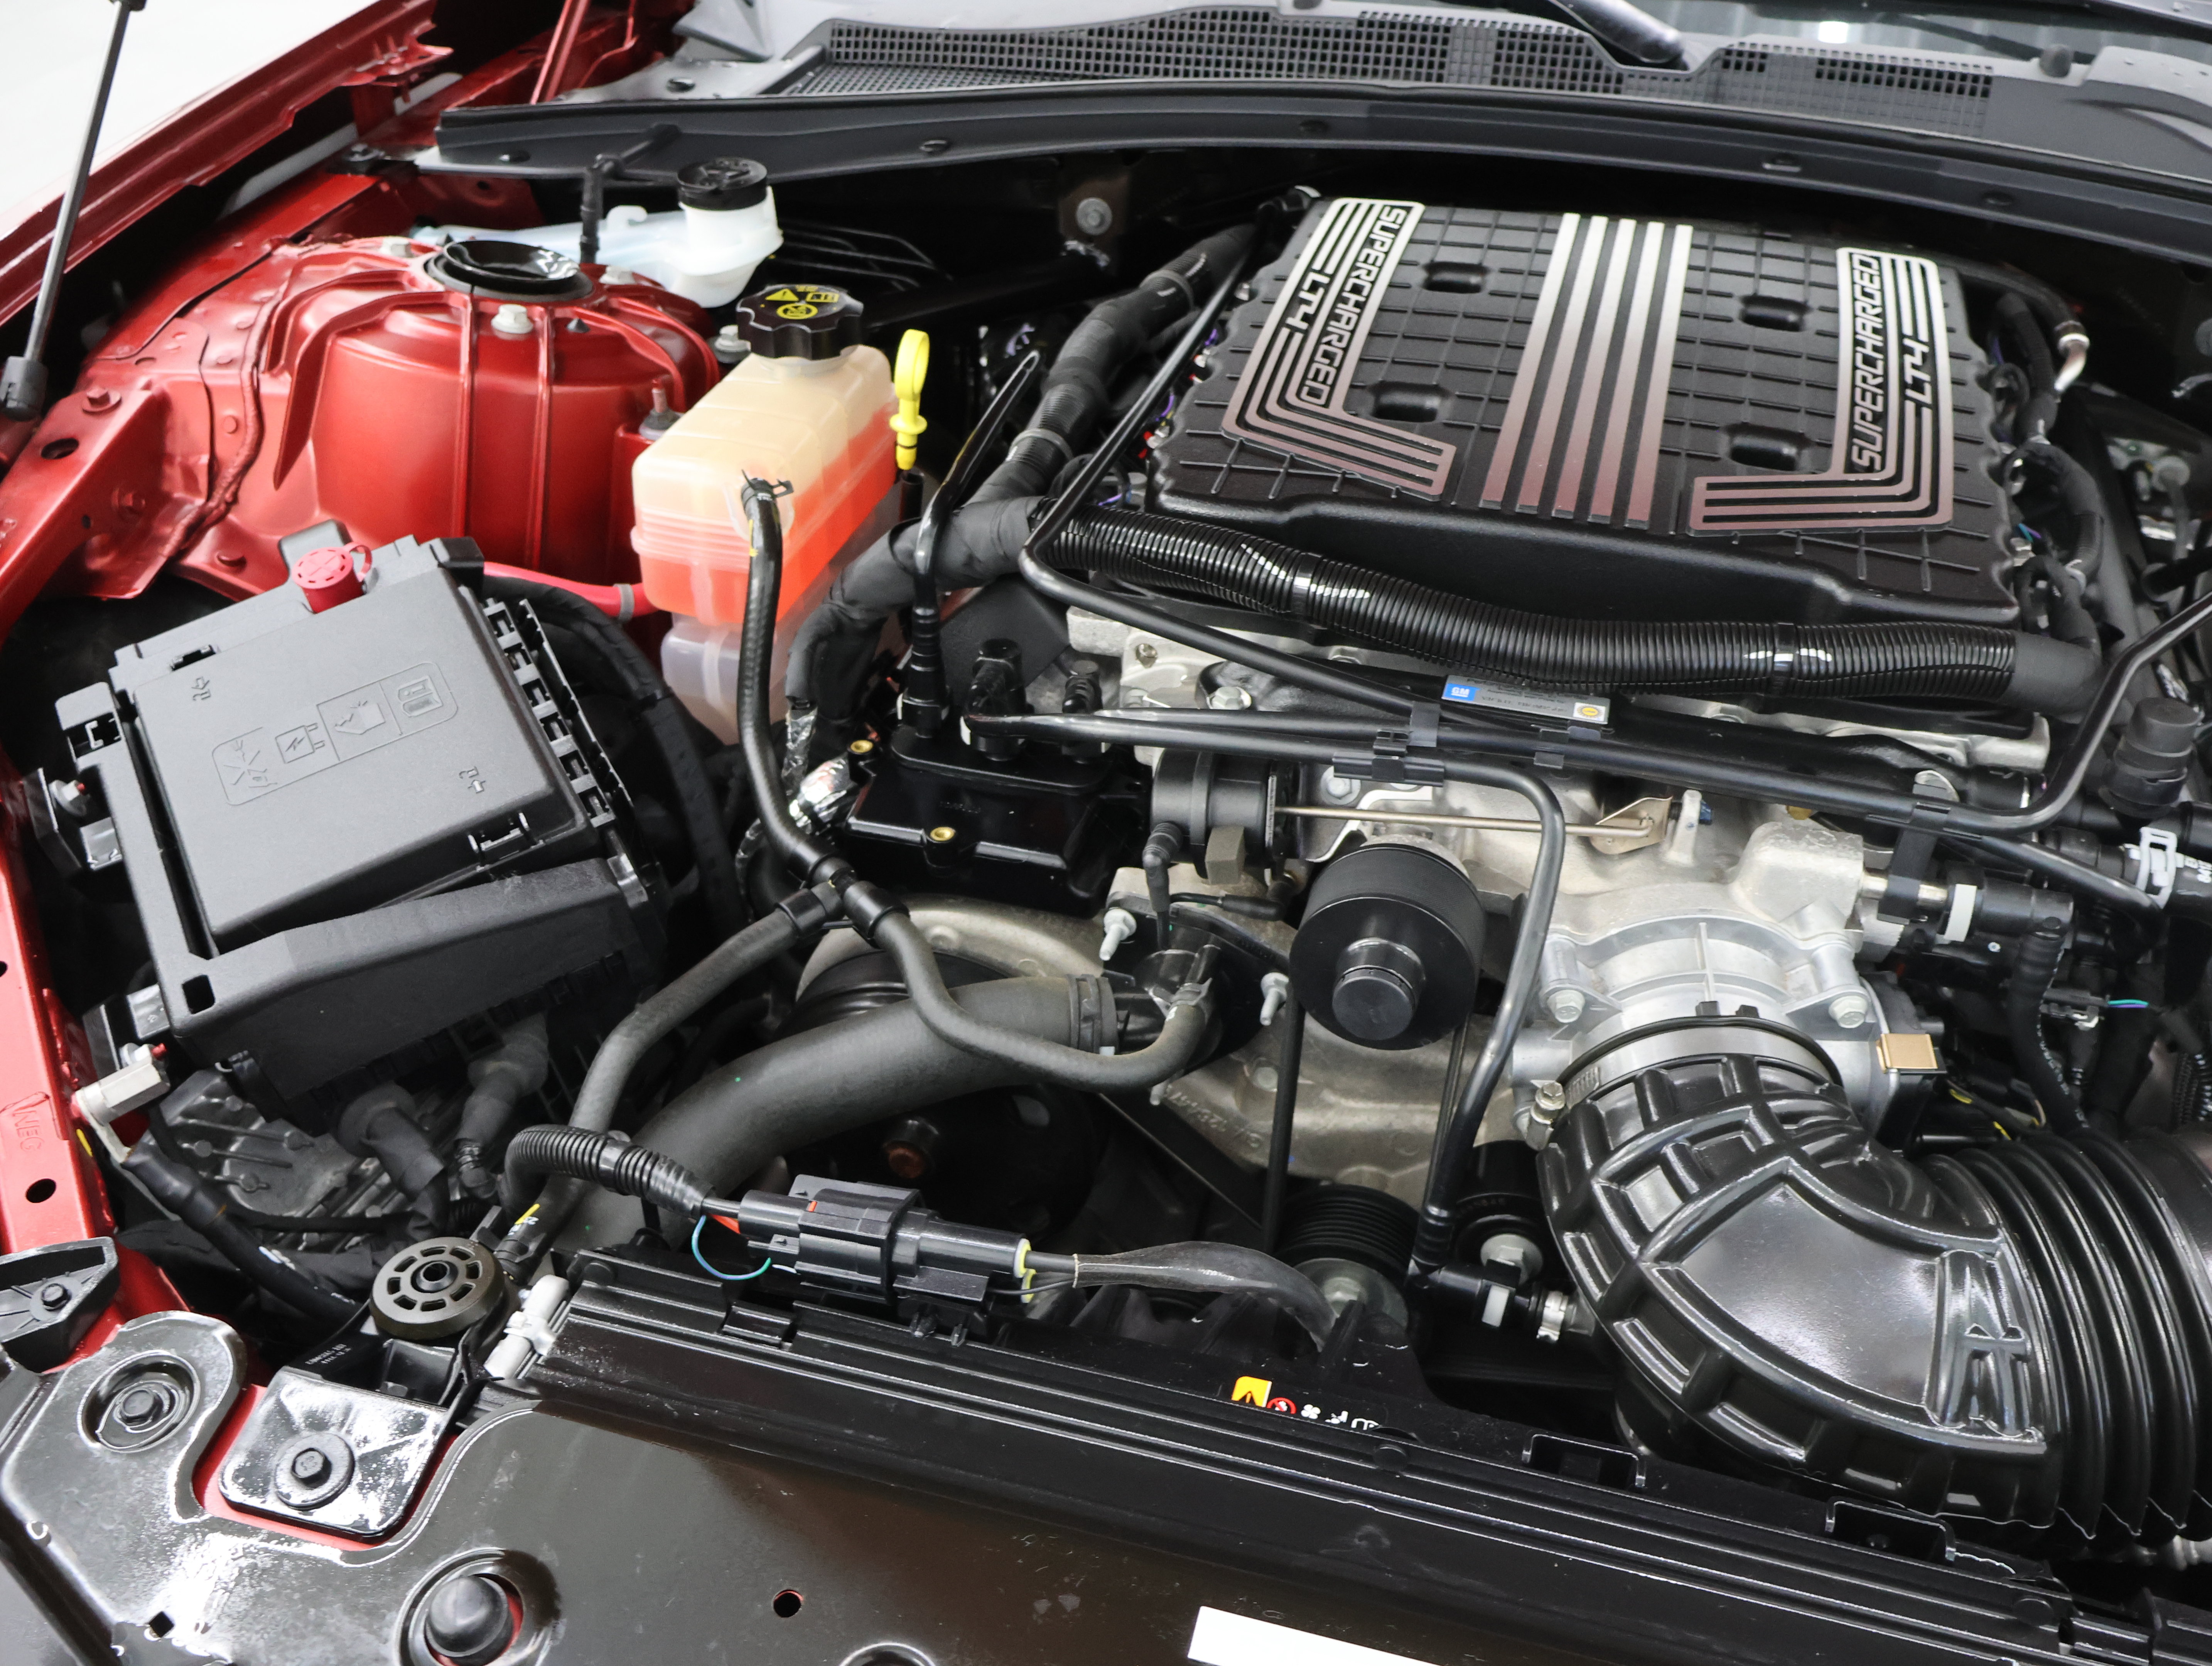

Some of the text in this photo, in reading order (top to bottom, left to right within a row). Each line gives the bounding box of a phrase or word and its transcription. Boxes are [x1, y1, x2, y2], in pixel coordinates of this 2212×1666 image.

[1285, 271, 1330, 330] LT4
[1301, 206, 1407, 405] SUPERCHARGED
[1852, 253, 1884, 470] SUPERCHARGED
[1902, 339, 1932, 405] LT4
[1451, 686, 1470, 696] GM
[12, 1110, 45, 1152] NEG
